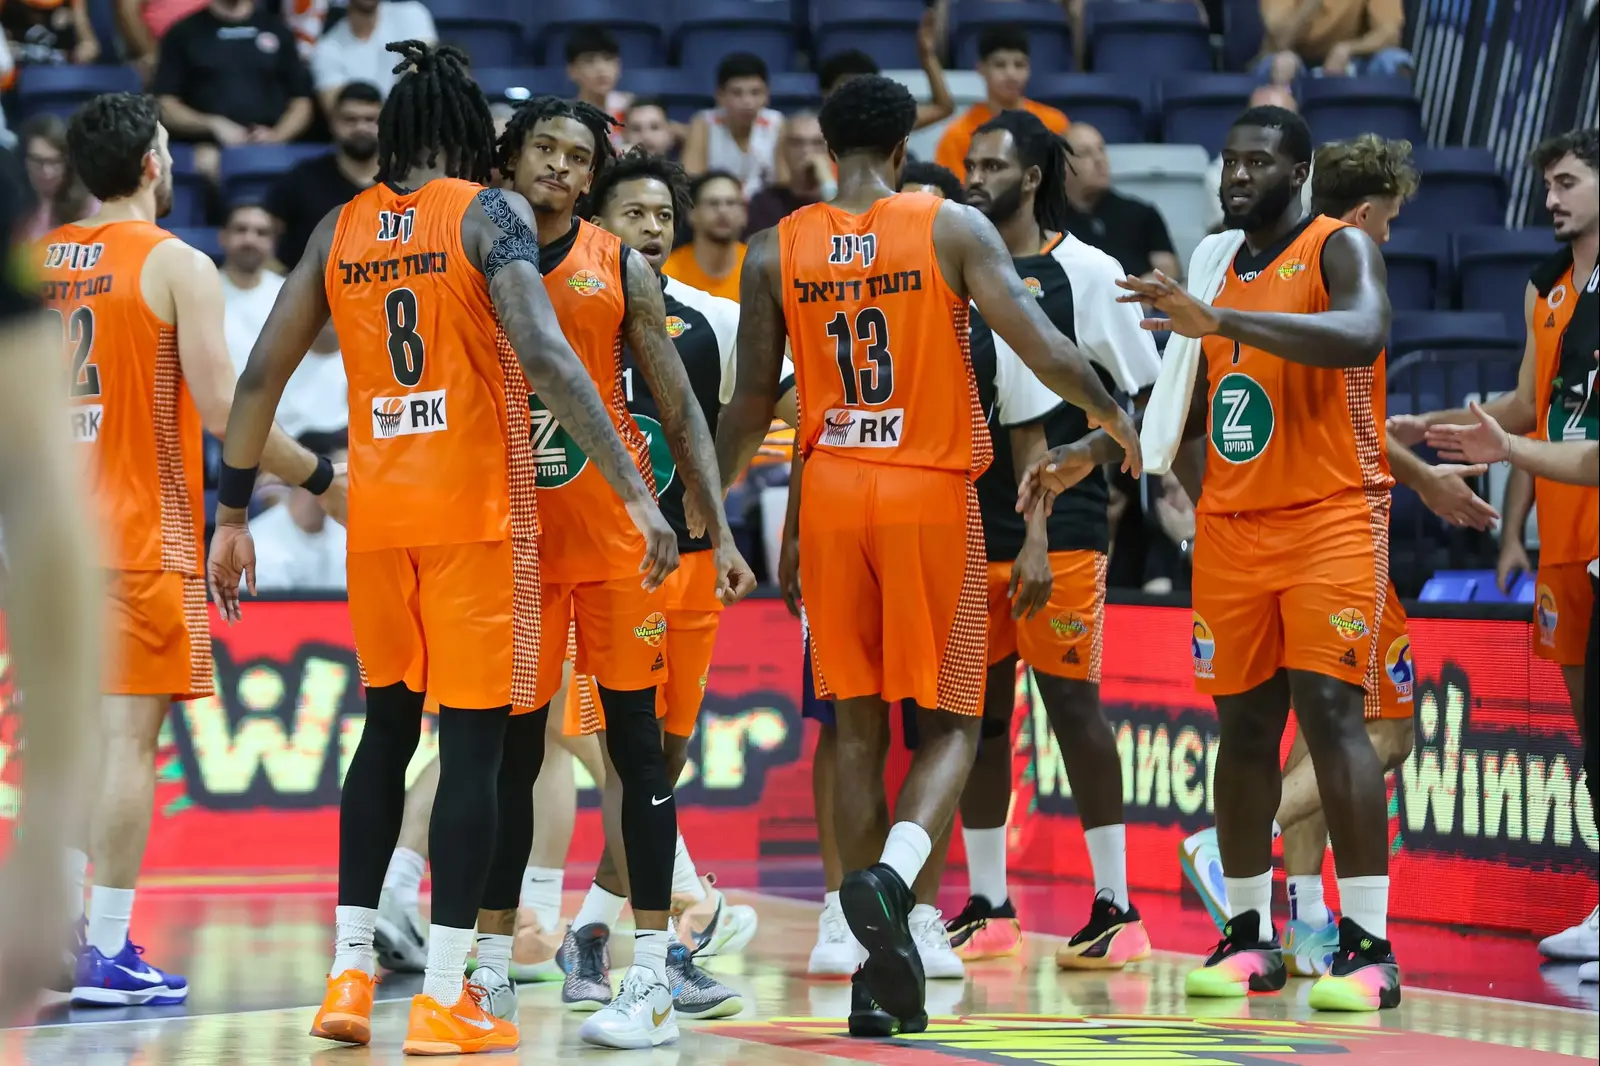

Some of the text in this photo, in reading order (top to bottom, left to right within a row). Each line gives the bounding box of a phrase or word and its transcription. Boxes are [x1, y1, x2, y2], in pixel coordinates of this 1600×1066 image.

[828, 232, 877, 268] קינג
[339, 259, 399, 284] דניאל
[794, 270, 922, 303] מעוז דניאל
[47, 304, 102, 399] 2
[385, 288, 425, 387] 8
[825, 307, 894, 406] 13
[71, 411, 100, 437] RK
[410, 397, 444, 428] RK
[1222, 389, 1252, 440] Z
[859, 416, 901, 443] RK
[535, 464, 568, 477] תפוזי
[634, 626, 665, 637] Winner
